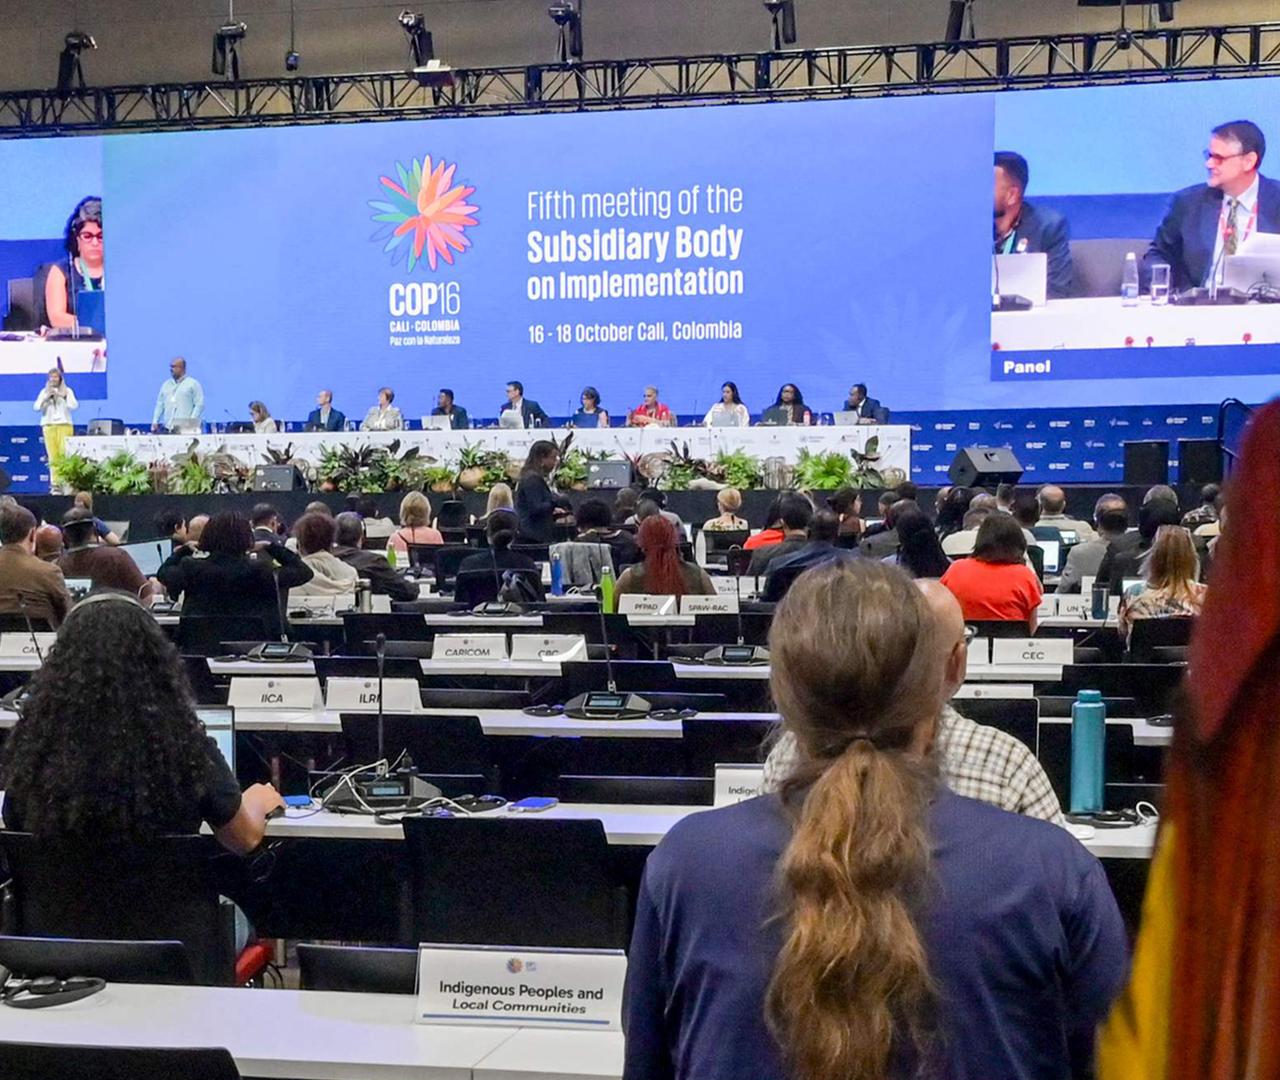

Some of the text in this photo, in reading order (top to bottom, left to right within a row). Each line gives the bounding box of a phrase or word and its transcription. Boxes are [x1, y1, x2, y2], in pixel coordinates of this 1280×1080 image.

[527, 184, 743, 220] Fifth meeting of the
[527, 224, 743, 263] Subsidiary Body
[527, 267, 743, 301] on Implementation
[389, 281, 461, 317] COP16
[389, 319, 460, 333] CALI COLOMBIA
[528, 324, 544, 343] 16
[556, 324, 571, 342] 18
[575, 322, 633, 342] October
[672, 320, 743, 341] Colombia
[1003, 359, 1051, 374] Panel
[444, 648, 491, 657] CARICOM
[1022, 651, 1045, 661] CEC
[260, 694, 284, 703] IICA
[439, 980, 604, 1001] Indigenous Peoples and
[452, 998, 587, 1015] Local Communities
